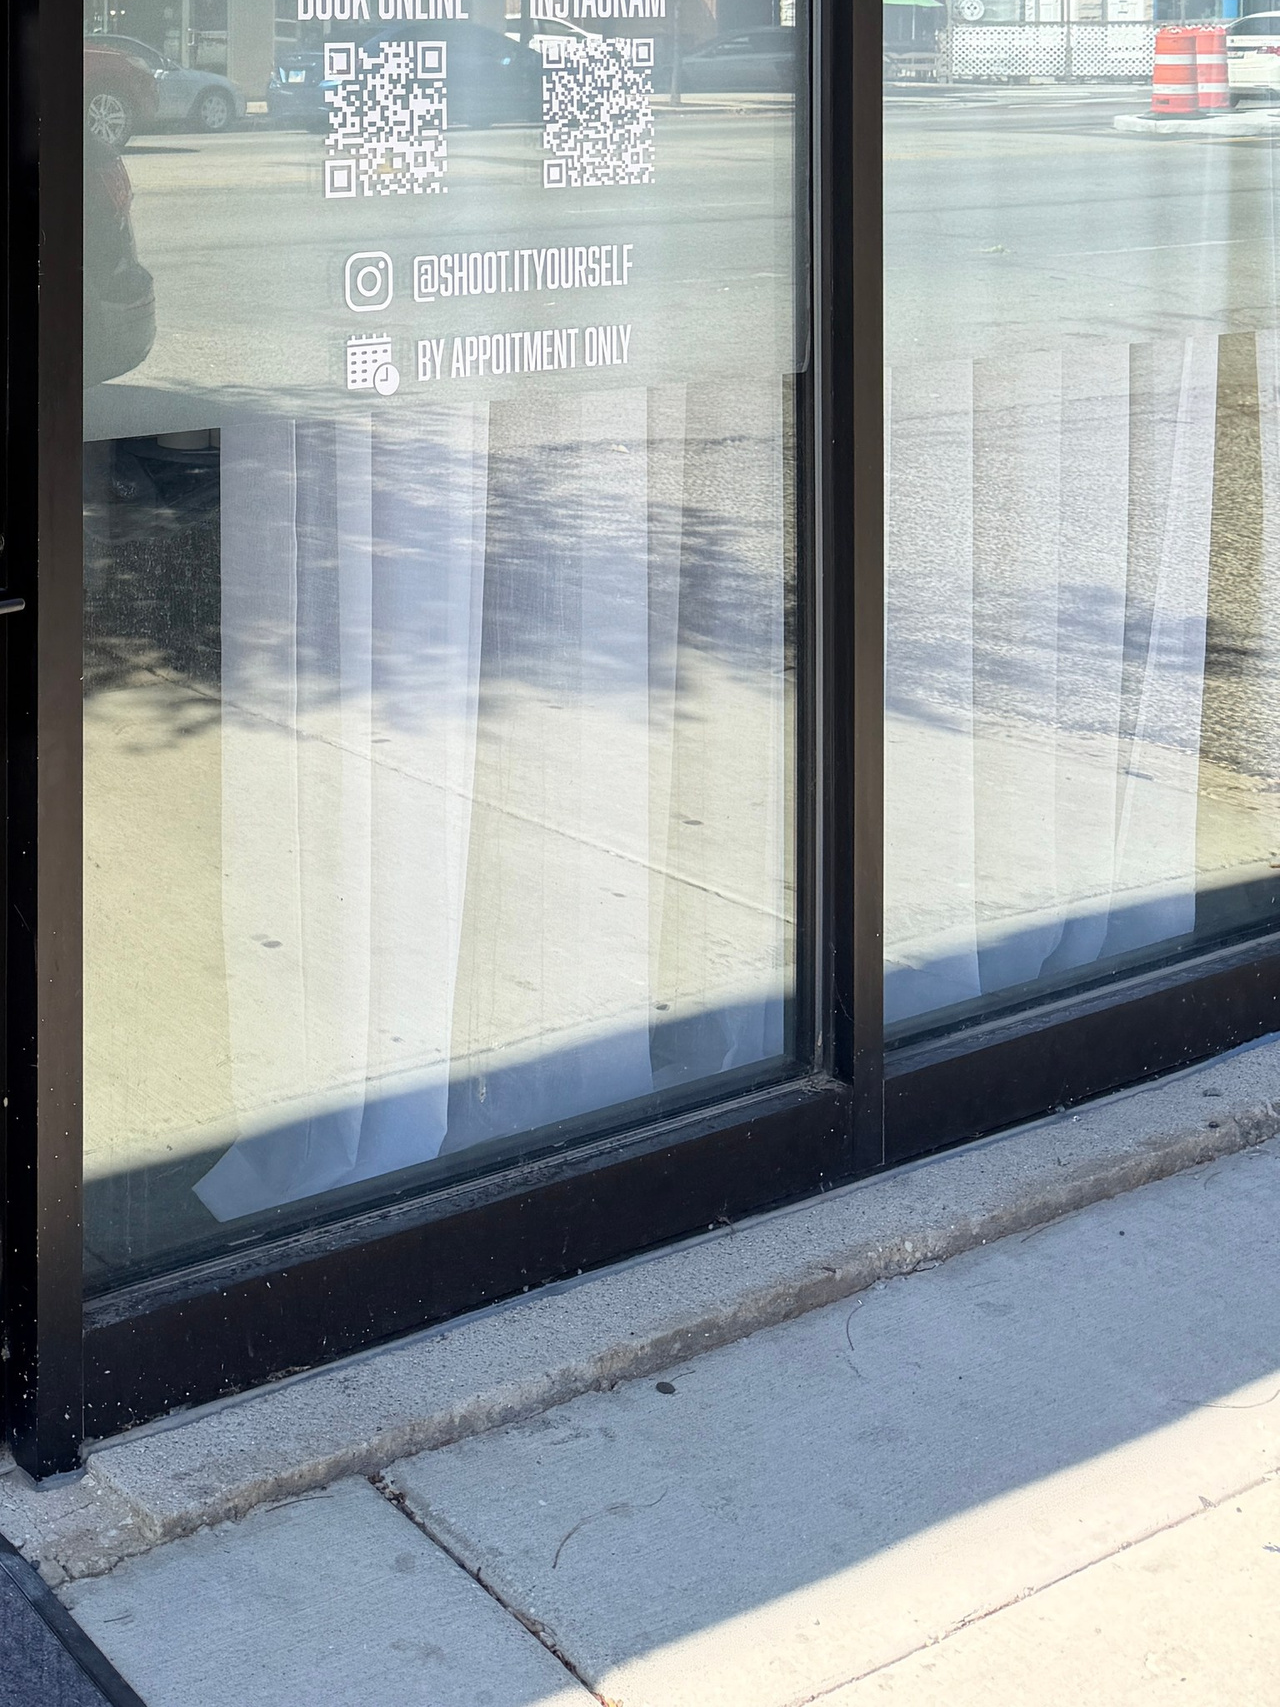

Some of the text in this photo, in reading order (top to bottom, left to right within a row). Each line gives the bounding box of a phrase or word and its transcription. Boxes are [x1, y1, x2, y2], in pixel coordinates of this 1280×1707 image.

[413, 244, 633, 302] @SHOOT.ITYOURSELF
[418, 324, 632, 382] BY APPOITMENT ONLY
